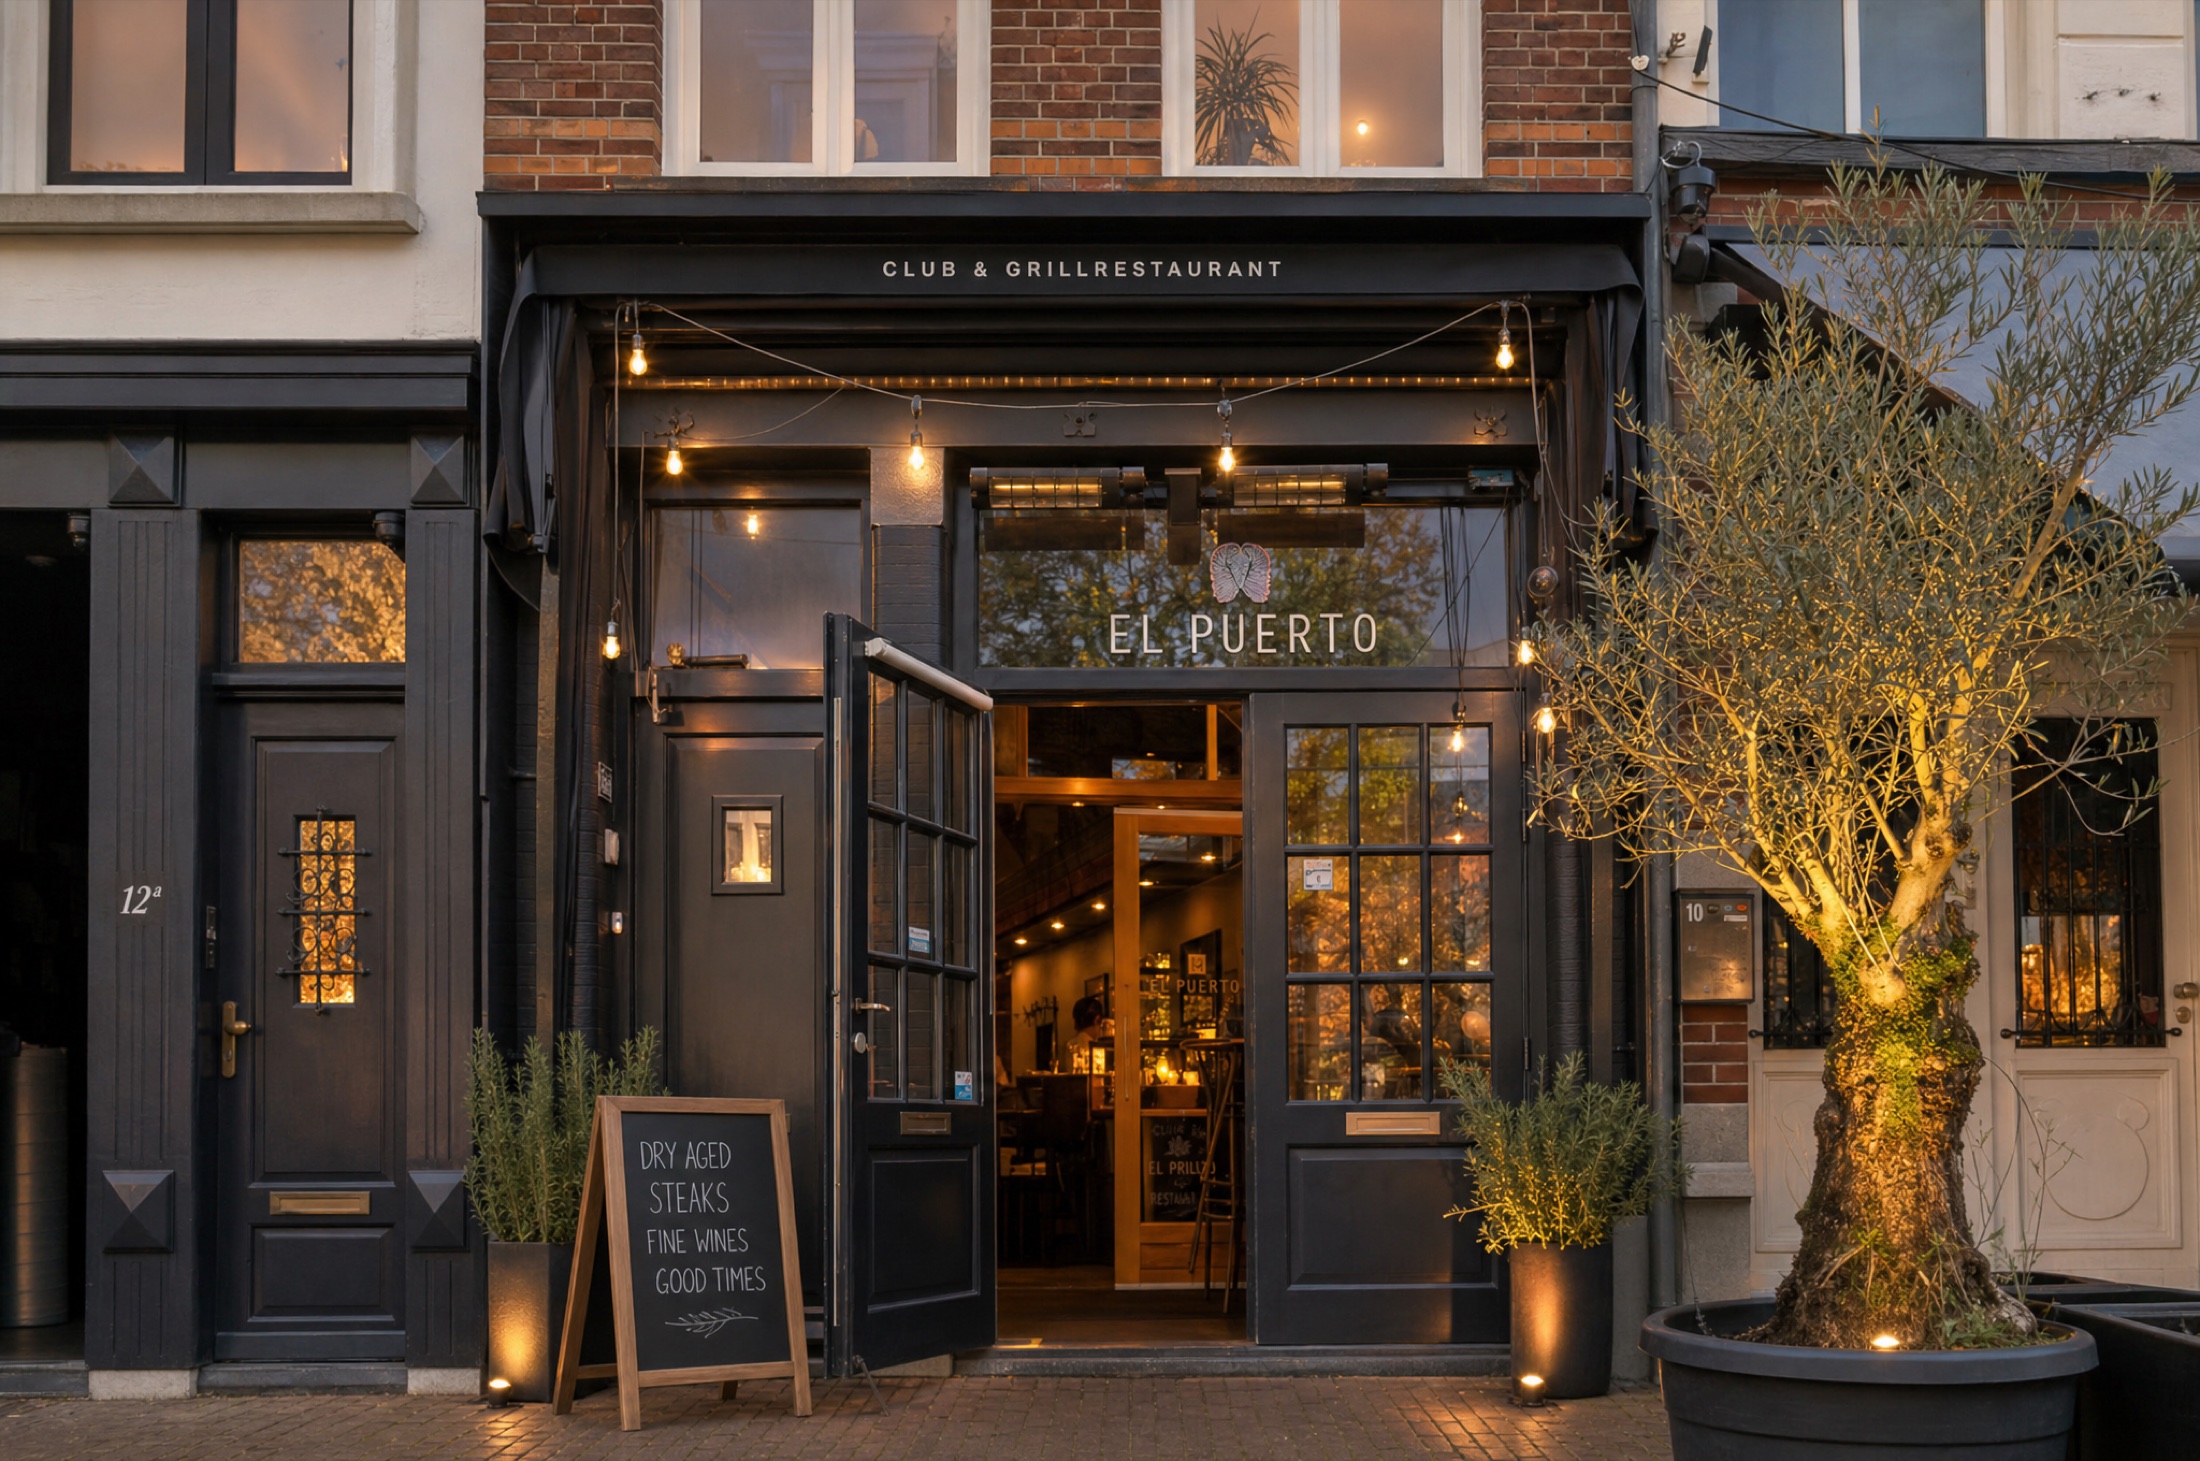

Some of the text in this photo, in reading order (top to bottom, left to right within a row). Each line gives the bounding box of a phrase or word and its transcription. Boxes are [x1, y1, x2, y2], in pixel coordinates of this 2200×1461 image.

[882, 261, 1282, 278] CLUB & GRILLRESTAURANT
[1109, 612, 1377, 654] EL PUERTO
[1685, 903, 1704, 922] 10
[1150, 979, 1240, 994] EL PUERTO
[640, 1141, 731, 1170] DRY AGED
[1148, 1161, 1164, 1175] EL
[650, 1182, 729, 1214] STEAKS
[647, 1228, 749, 1255] FINE WINES
[655, 1266, 766, 1294] GOOD TIMES
